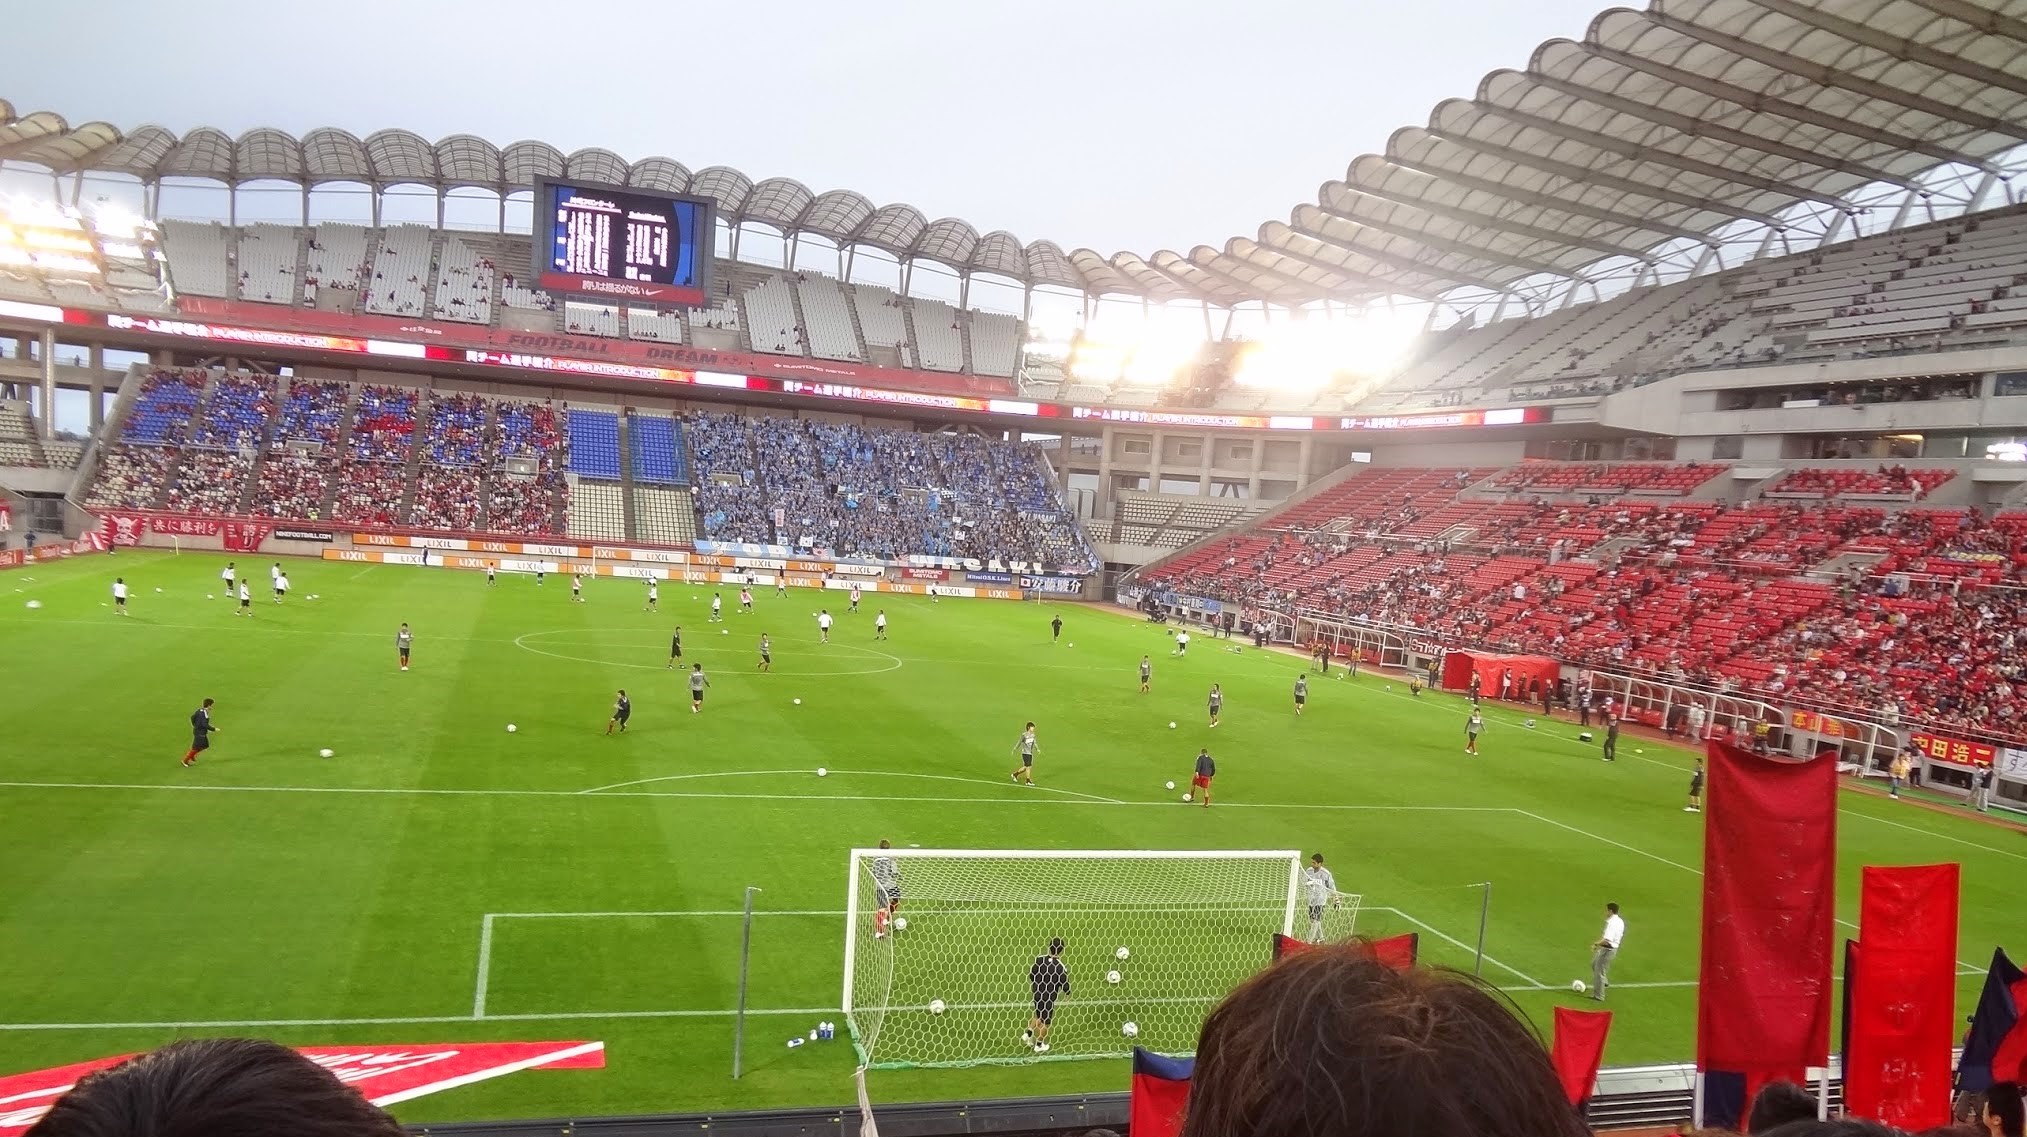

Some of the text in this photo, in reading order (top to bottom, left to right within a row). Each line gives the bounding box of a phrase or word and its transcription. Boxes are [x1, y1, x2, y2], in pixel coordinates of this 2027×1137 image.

[509, 334, 609, 355] FOOTBALL
[646, 350, 718, 366] DREAM
[595, 364, 659, 378] INTRODUCTION
[153, 519, 216, 535] 共に勝利を
[369, 535, 396, 545] LIXIL
[426, 539, 452, 548] LIXIL
[482, 542, 508, 552] LIXIL
[538, 546, 563, 555] LIXIL
[340, 551, 368, 561] LIXIL
[400, 554, 422, 564] LIXI
[646, 553, 669, 561] LIXIL
[699, 555, 721, 565] LIXIL
[458, 557, 485, 568] LIXIL
[516, 561, 538, 570] LIXI
[750, 559, 772, 568] LIXIL
[800, 562, 822, 572] LIXIL
[629, 568, 653, 577] LIXIL
[849, 566, 871, 574] LIXIL
[908, 568, 943, 576] SUMITOMO
[682, 571, 707, 581] LIXIL
[788, 577, 812, 587] LIXIL
[890, 583, 913, 593] LIXIL
[940, 586, 962, 596] LIXIL
[988, 589, 1010, 599] LIXIL
[1911, 736, 1991, 766] 中田浩二
